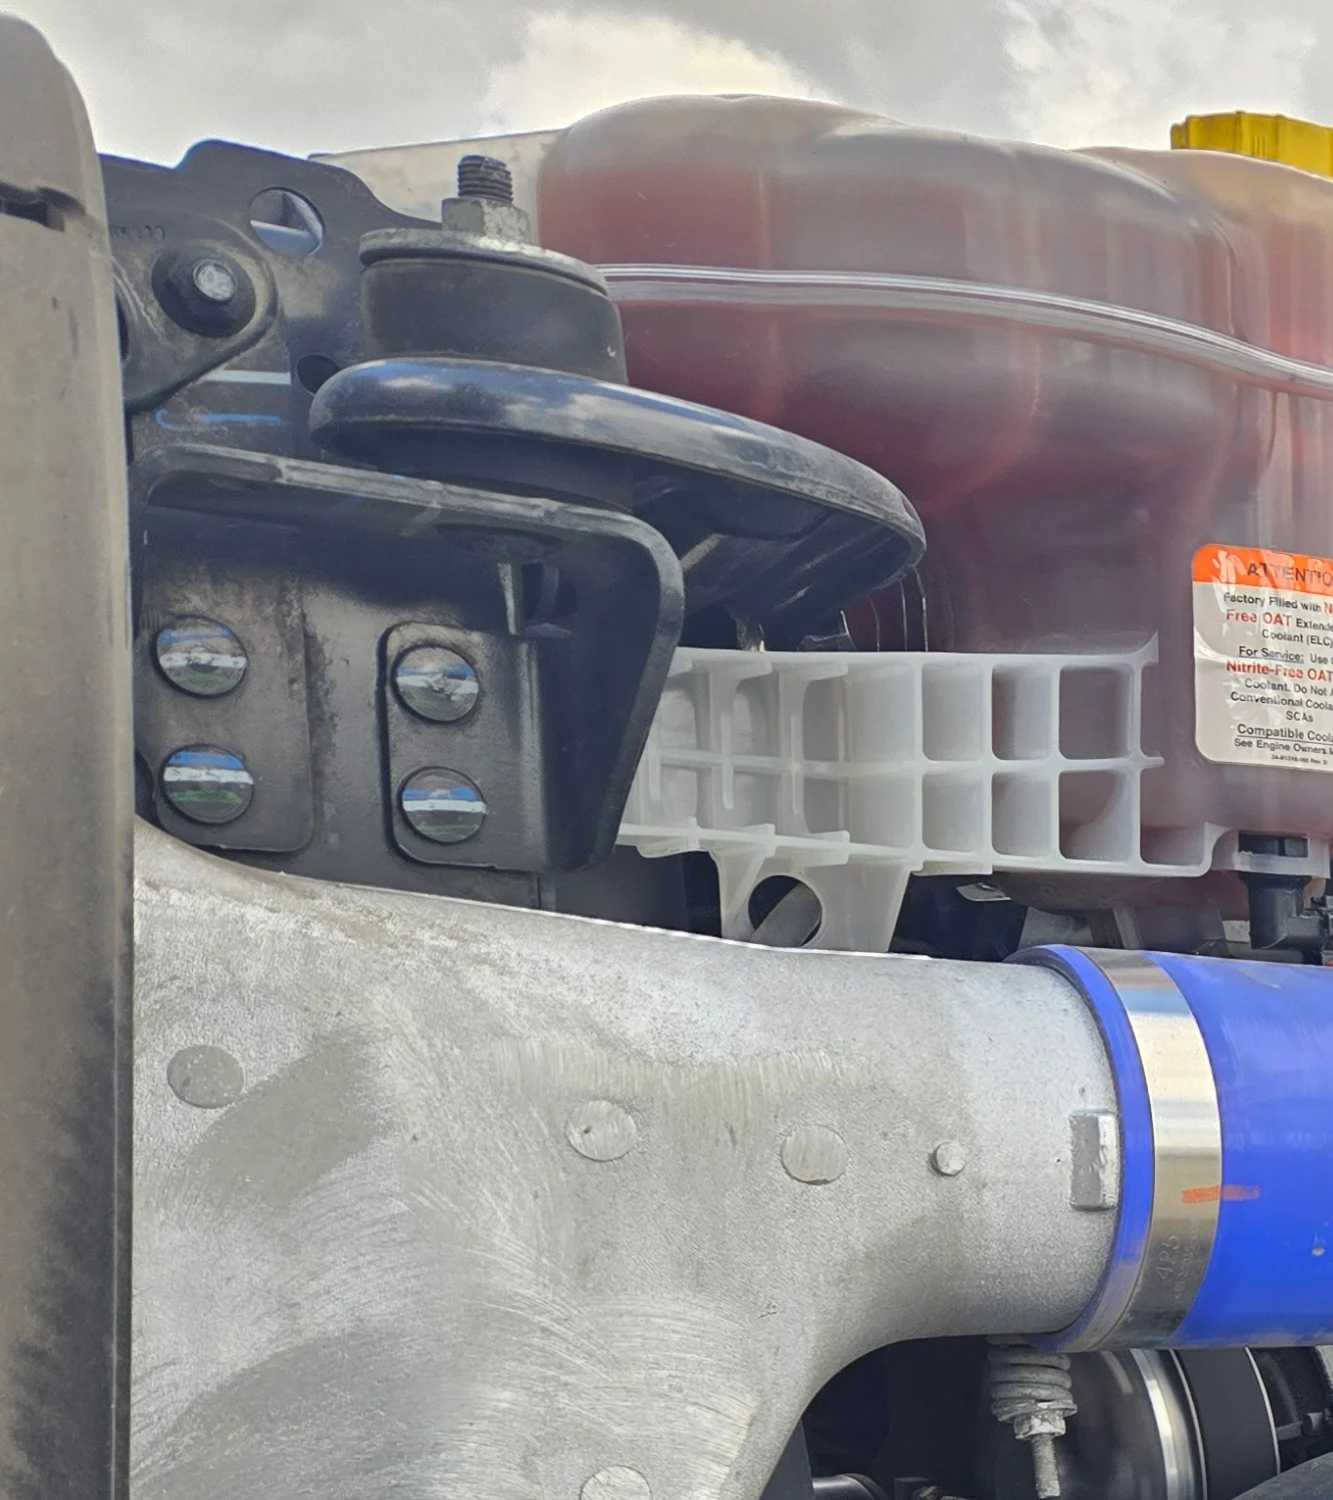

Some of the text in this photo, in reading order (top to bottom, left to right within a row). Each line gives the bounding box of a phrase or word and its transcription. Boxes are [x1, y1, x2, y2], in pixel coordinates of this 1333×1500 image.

[1224, 592, 1265, 607] Factory
[1269, 596, 1298, 609] Filled
[1300, 601, 1322, 613] with
[1226, 609, 1257, 623] Free
[1263, 612, 1292, 627] OAT
[1262, 628, 1333, 649] Coolant (ELC)
[1239, 646, 1258, 657] For
[1261, 648, 1304, 662] Service:
[1310, 653, 1328, 665] Use
[1226, 660, 1303, 679] Nitrite-Free
[1307, 668, 1333, 683] OAT
[1294, 684, 1307, 694] Do
[1310, 686, 1327, 696] Not
[1230, 691, 1303, 707] Conventional
[1286, 710, 1314, 723] SCAs
[1237, 723, 1304, 740] Compatible
[1234, 738, 1253, 748] See
[1256, 740, 1290, 752] Engine
[1293, 744, 1327, 755] Owners
